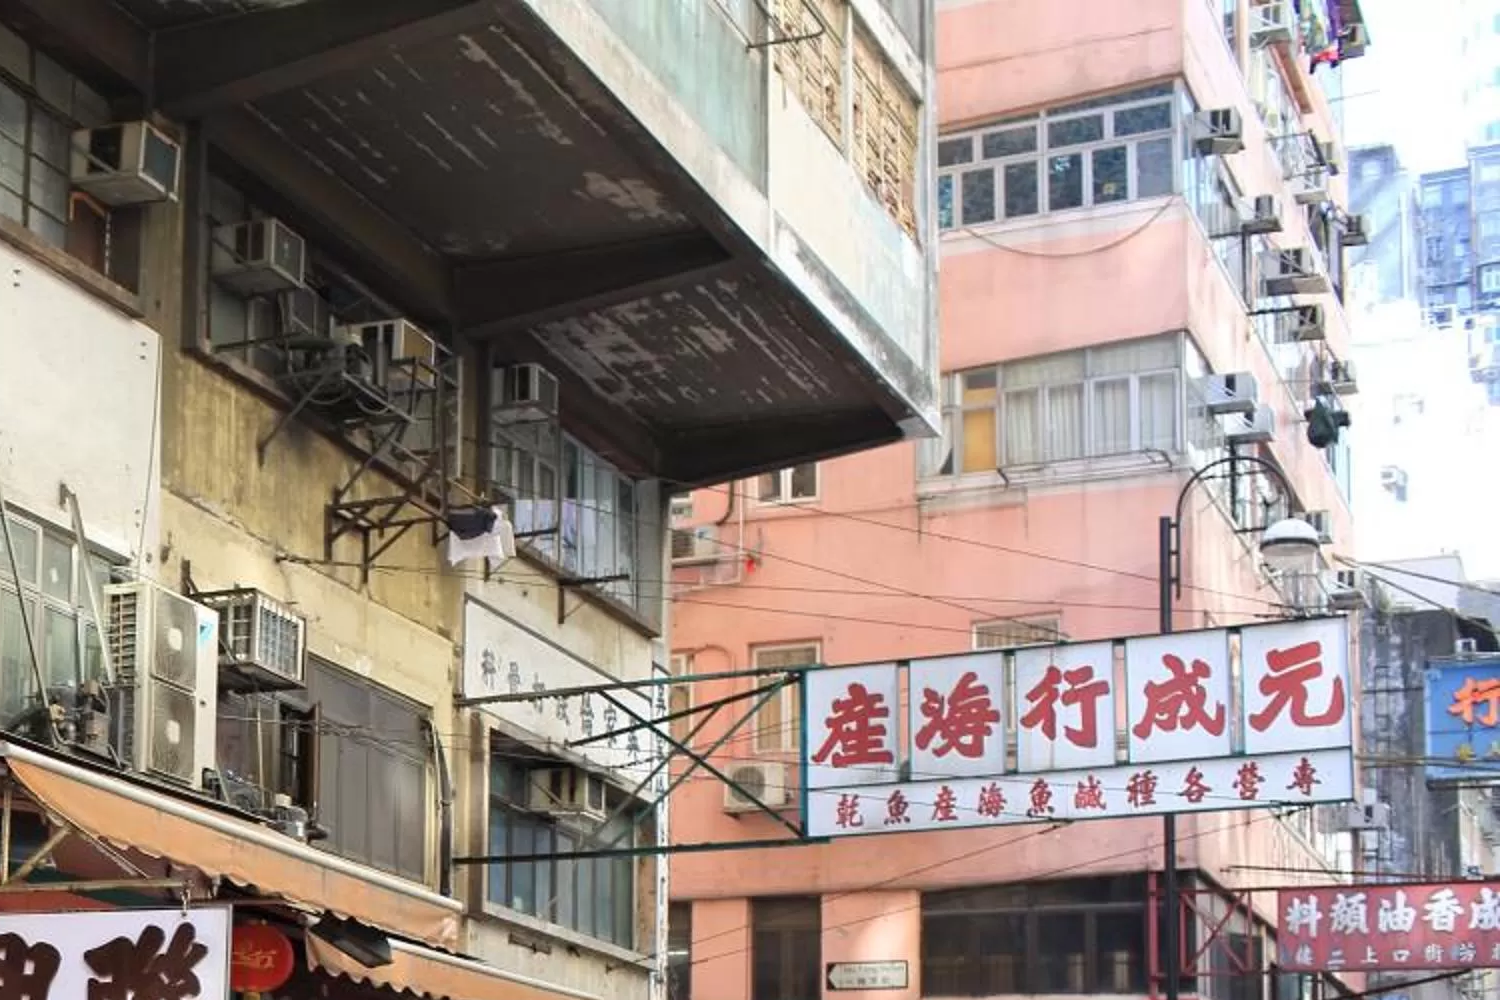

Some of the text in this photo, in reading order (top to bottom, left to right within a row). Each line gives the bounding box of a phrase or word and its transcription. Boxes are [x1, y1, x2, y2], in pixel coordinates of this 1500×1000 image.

[811, 639, 1346, 769] 元成行海產
